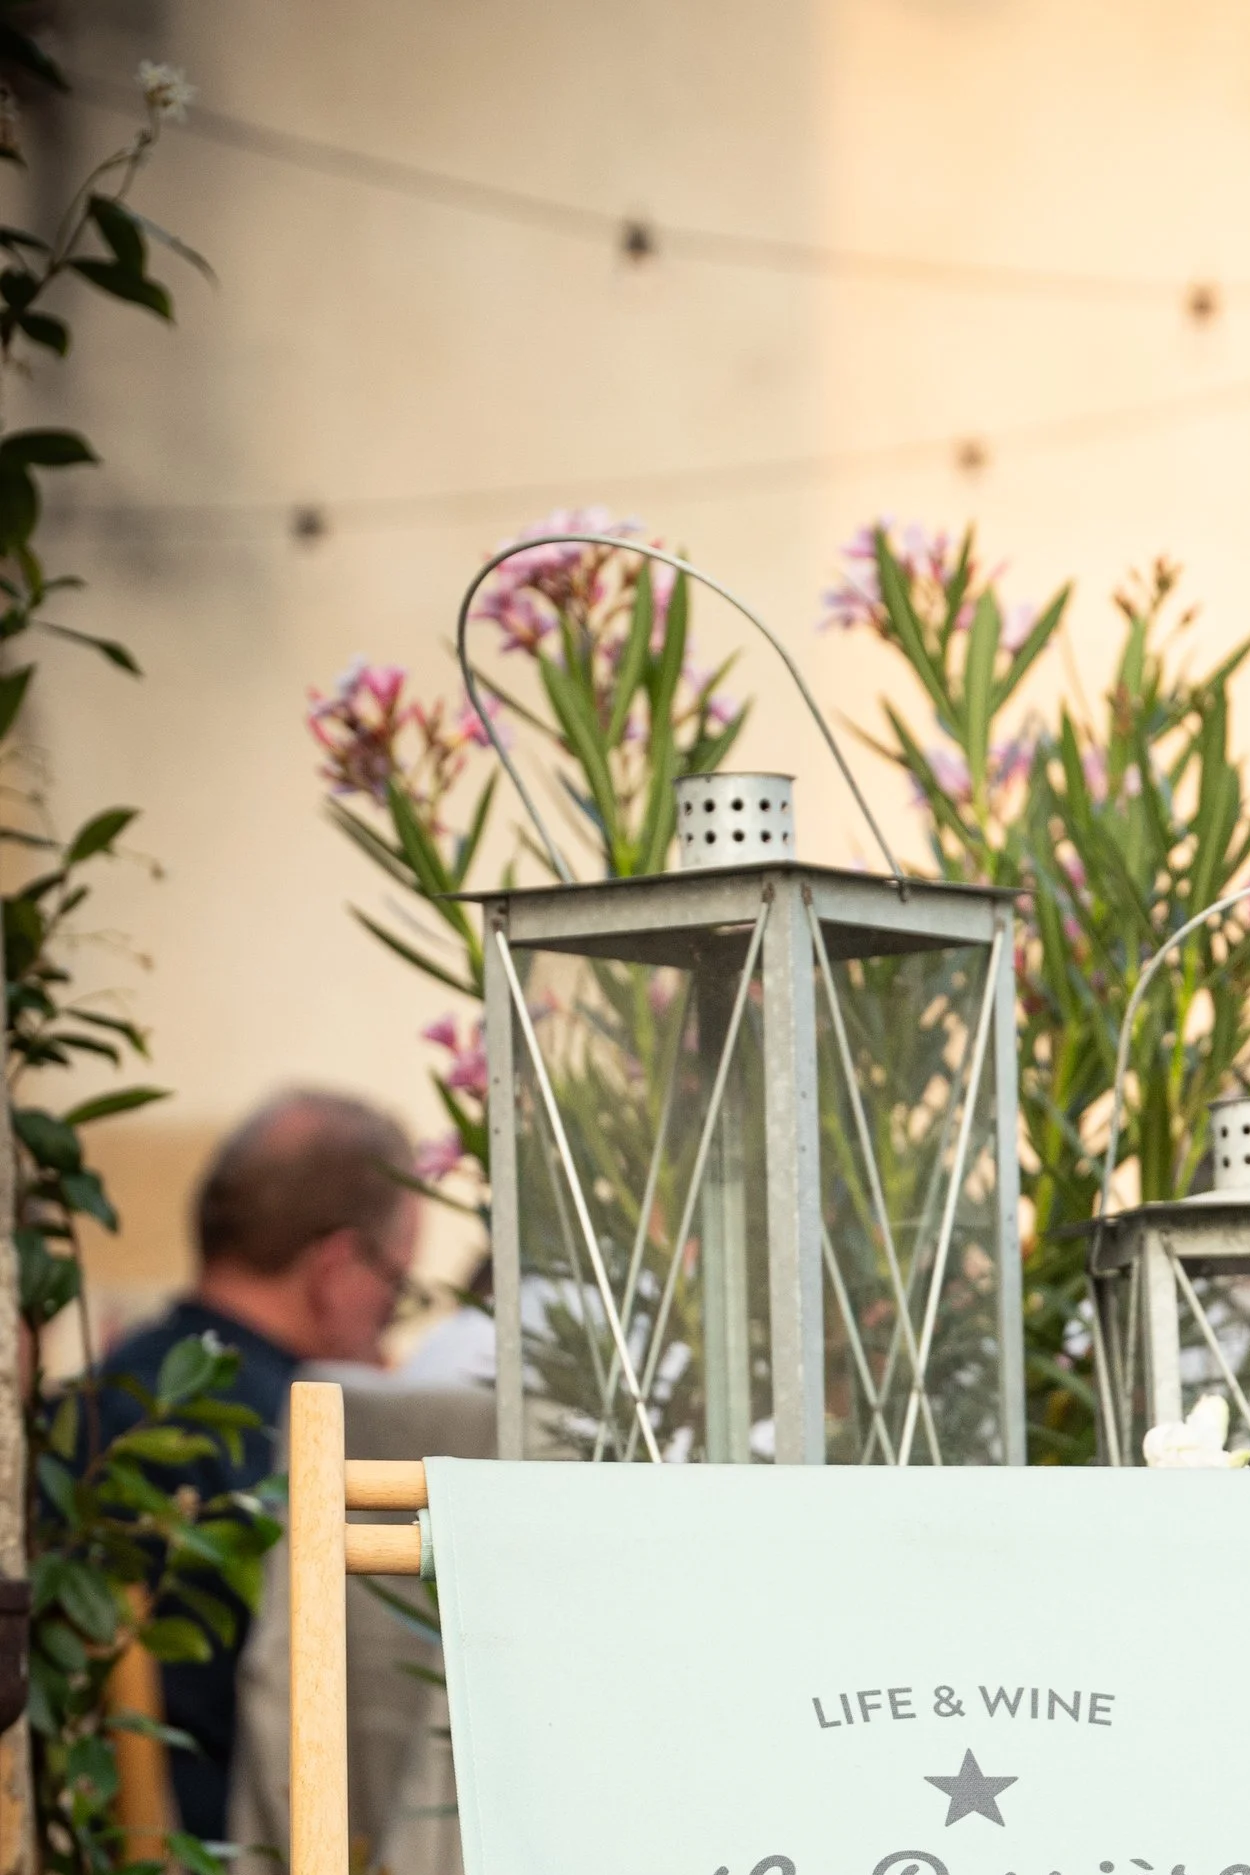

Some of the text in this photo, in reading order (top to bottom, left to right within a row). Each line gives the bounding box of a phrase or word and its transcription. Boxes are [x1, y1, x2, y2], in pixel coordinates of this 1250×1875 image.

[811, 1684, 1116, 1729] LIFE & WINE
